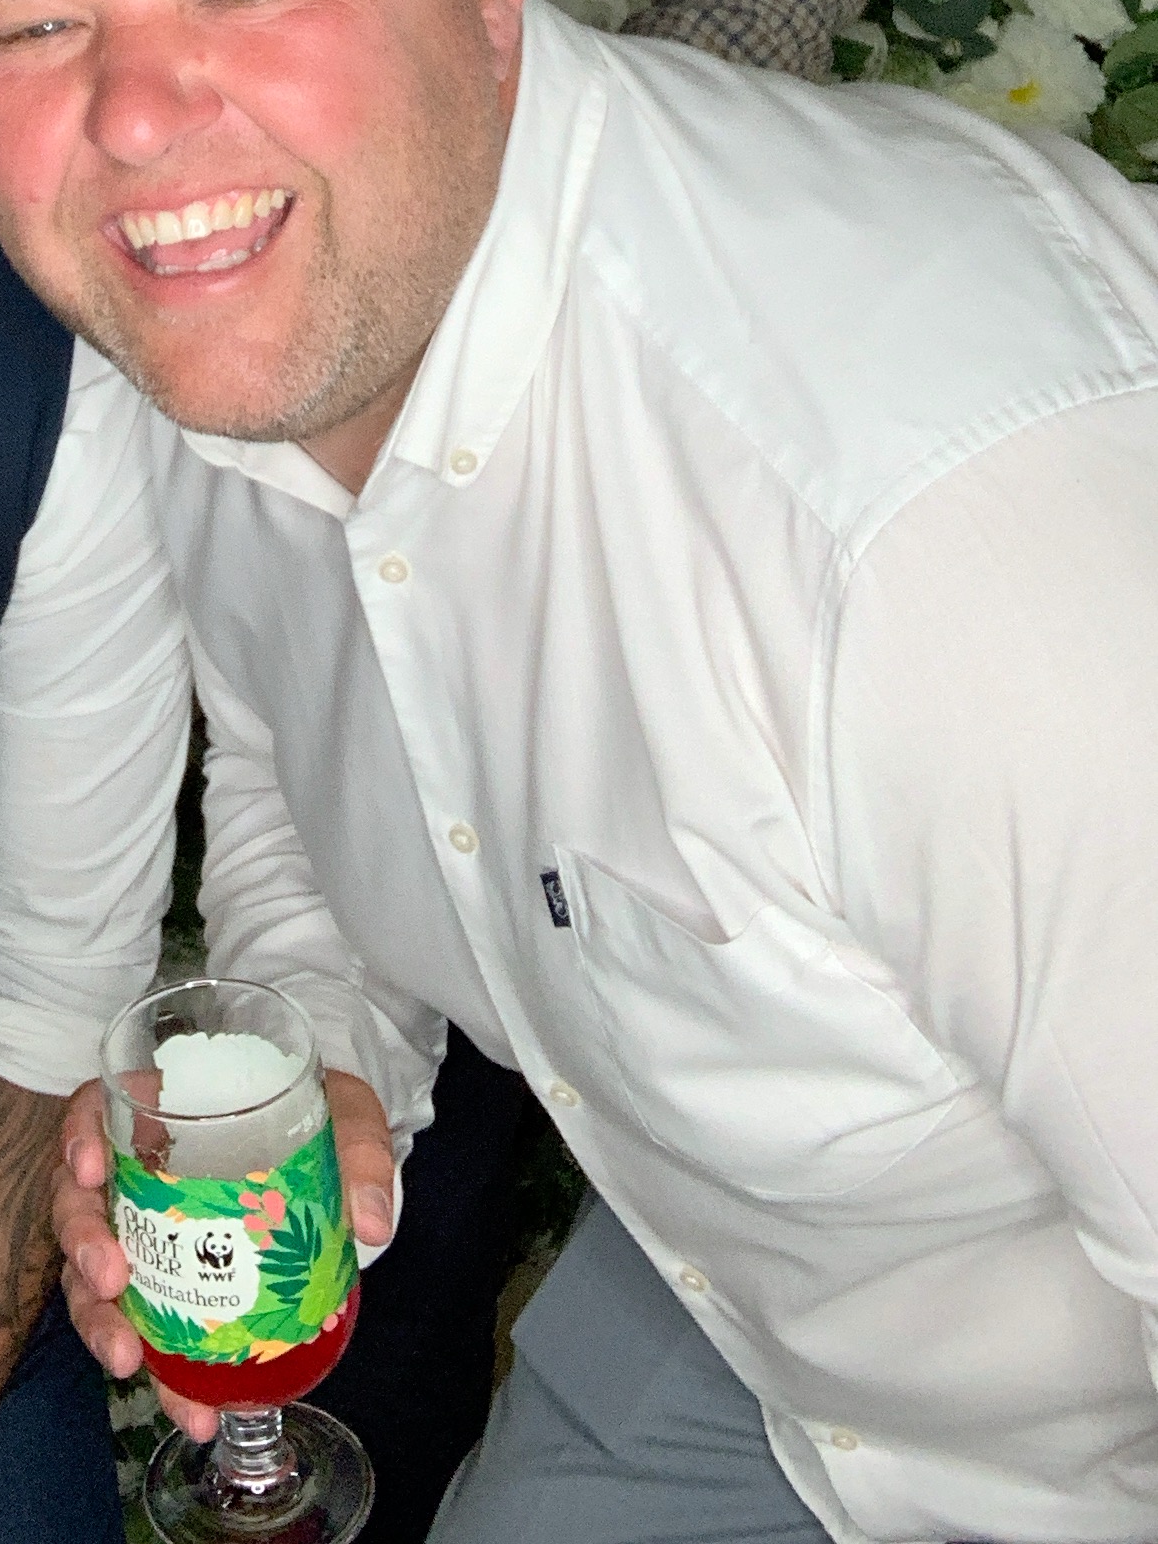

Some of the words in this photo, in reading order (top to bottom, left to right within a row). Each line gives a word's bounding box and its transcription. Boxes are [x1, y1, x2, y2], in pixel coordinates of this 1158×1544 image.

[123, 1205, 157, 1235] OLD
[124, 1235, 184, 1278] CIDER
[125, 1219, 184, 1259] MOUT
[197, 1270, 236, 1283] WWF
